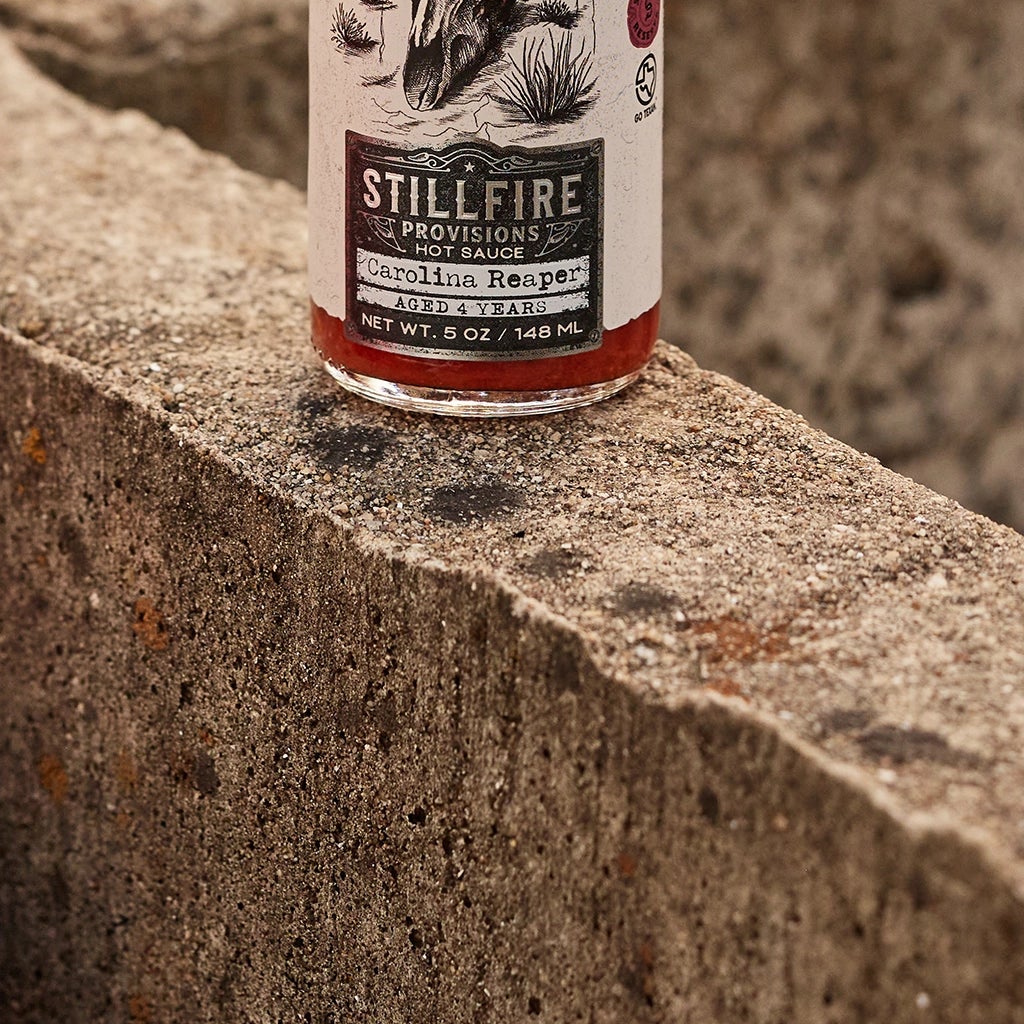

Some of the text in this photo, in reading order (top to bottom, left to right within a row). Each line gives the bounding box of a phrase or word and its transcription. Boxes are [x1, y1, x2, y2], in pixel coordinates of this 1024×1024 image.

[634, 111, 643, 123] GO
[362, 168, 582, 221] STILLFIRE
[401, 220, 540, 243] PROVISIONS
[415, 245, 524, 260] HOT SAUCE
[367, 259, 581, 291] Carolina Reaper
[394, 295, 547, 315] AGED 4 YEARS
[362, 312, 584, 341] NET WT. 5 OZ / 148 ML
